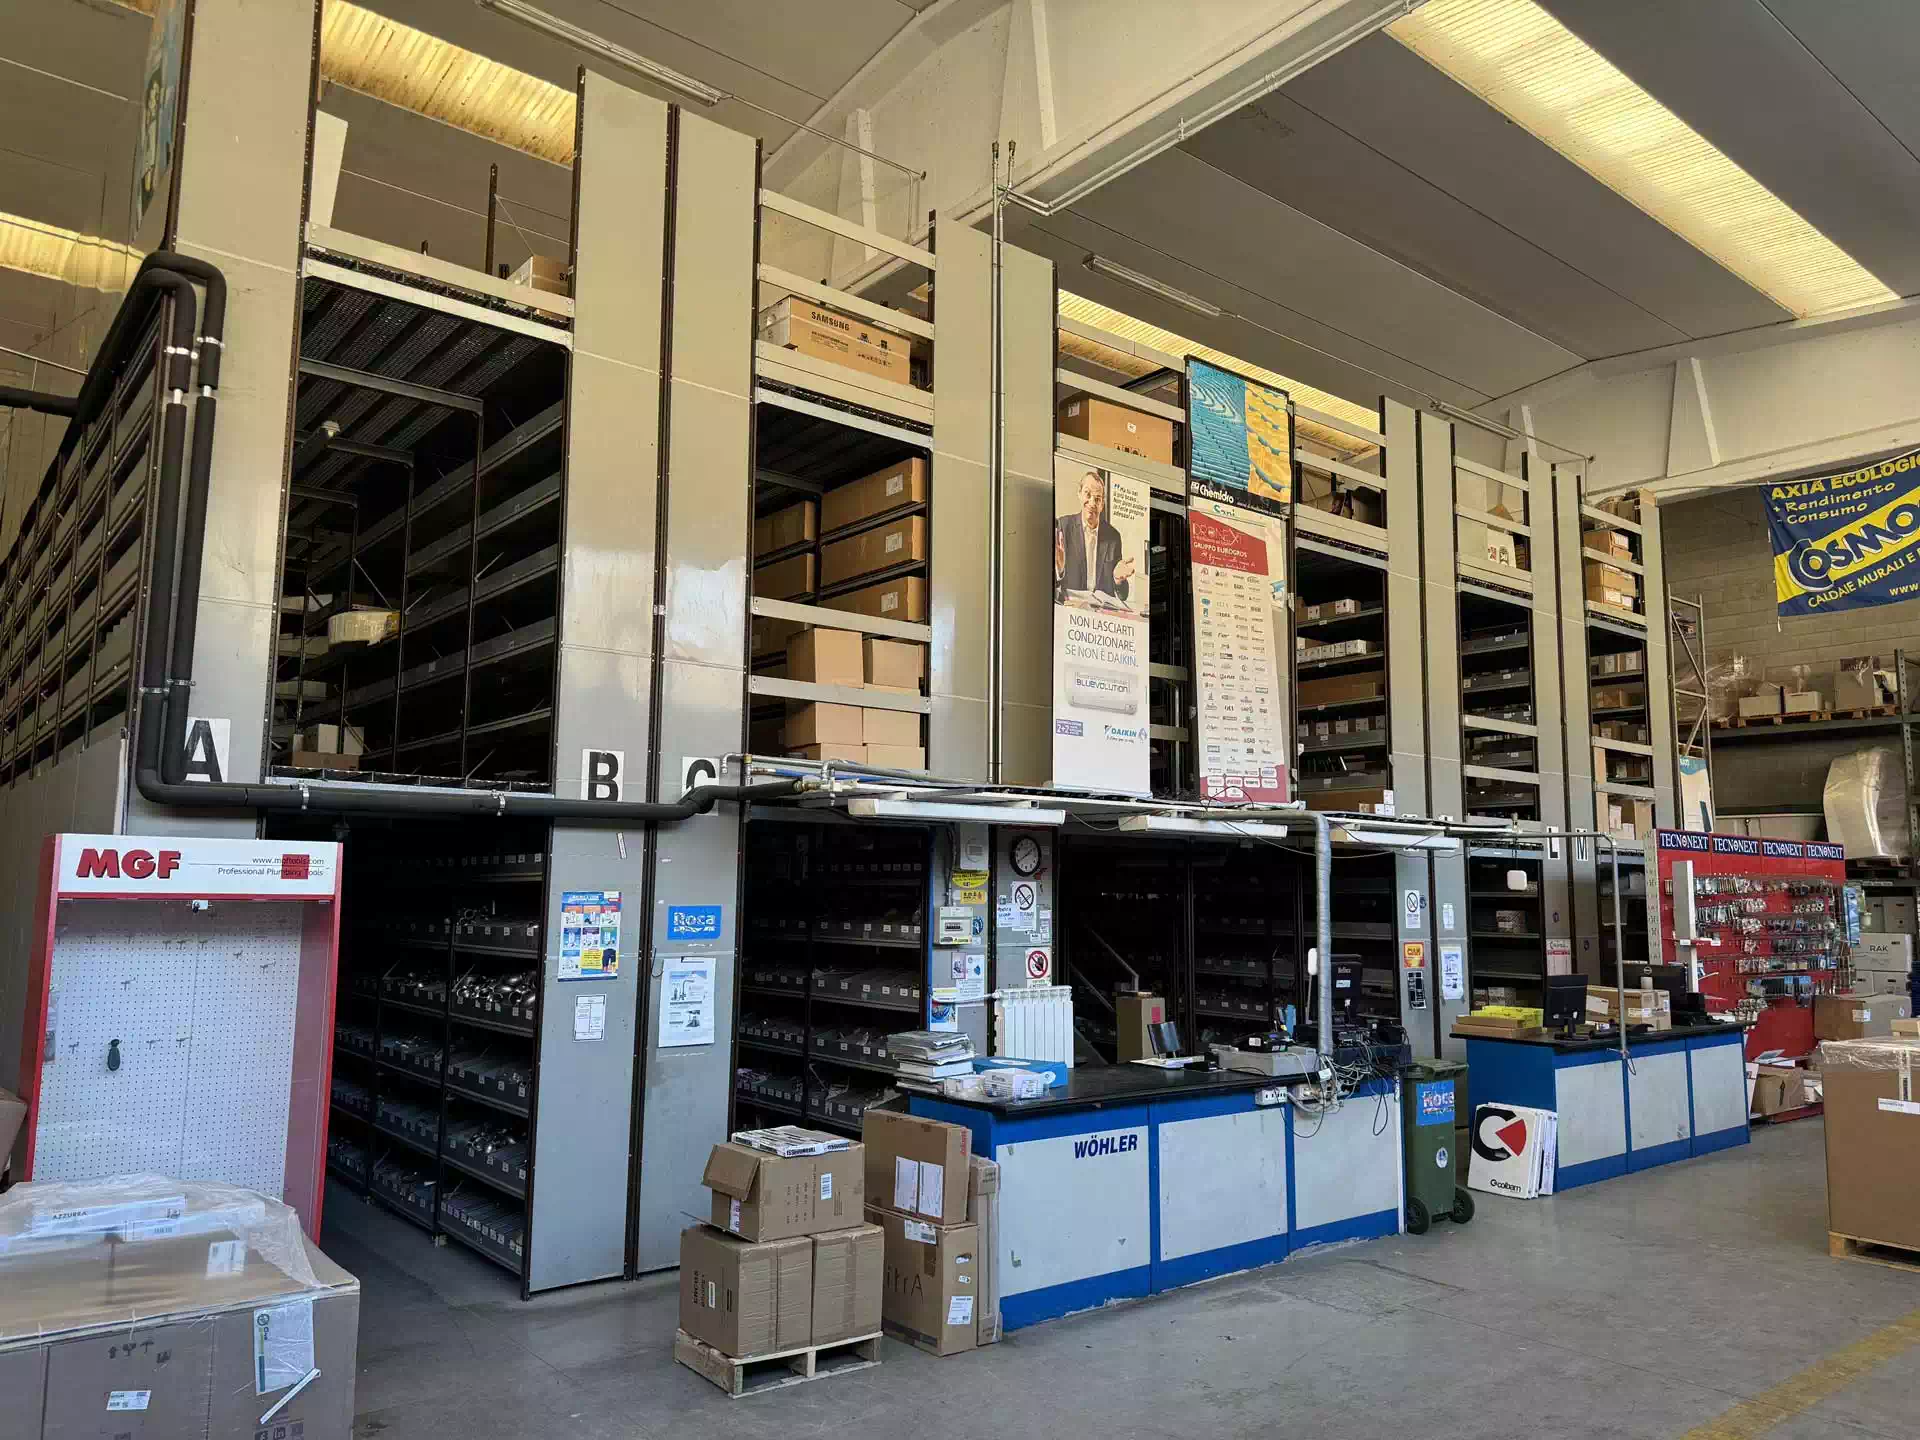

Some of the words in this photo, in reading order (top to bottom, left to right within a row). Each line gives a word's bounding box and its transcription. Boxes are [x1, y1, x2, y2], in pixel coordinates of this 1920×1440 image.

[811, 311, 850, 331] SAMSUNG
[1200, 484, 1234, 503] Chemidro
[1771, 479, 1825, 500] AXIA
[1785, 482, 1896, 512] Rendimento
[1786, 502, 1868, 524] Consumo
[1787, 500, 1920, 592] COSMO
[1808, 581, 1857, 608] CALDAIE
[1857, 556, 1905, 588] MURALI
[1906, 552, 1916, 563] E
[1069, 614, 1090, 628] NON
[1093, 619, 1135, 636] LASCIARTI
[1067, 629, 1136, 653] CONDIZIONARE,
[1065, 644, 1076, 656] SE
[1078, 646, 1098, 660] NON
[1107, 651, 1139, 668] DAIKIN.
[1111, 727, 1137, 737] DAIKIN
[181, 720, 223, 783] A
[588, 751, 619, 801] B
[1660, 832, 1708, 850] TECNONEXT
[1713, 837, 1759, 854] TECNONEXT
[1763, 841, 1803, 857] TECNONEXT
[1806, 844, 1843, 859] TECNONEXT
[76, 848, 181, 879] MGF
[218, 867, 264, 876] Professional
[266, 867, 301, 878] Plumbing
[304, 867, 323, 877] Tools
[1074, 1134, 1138, 1159] WÖHLER
